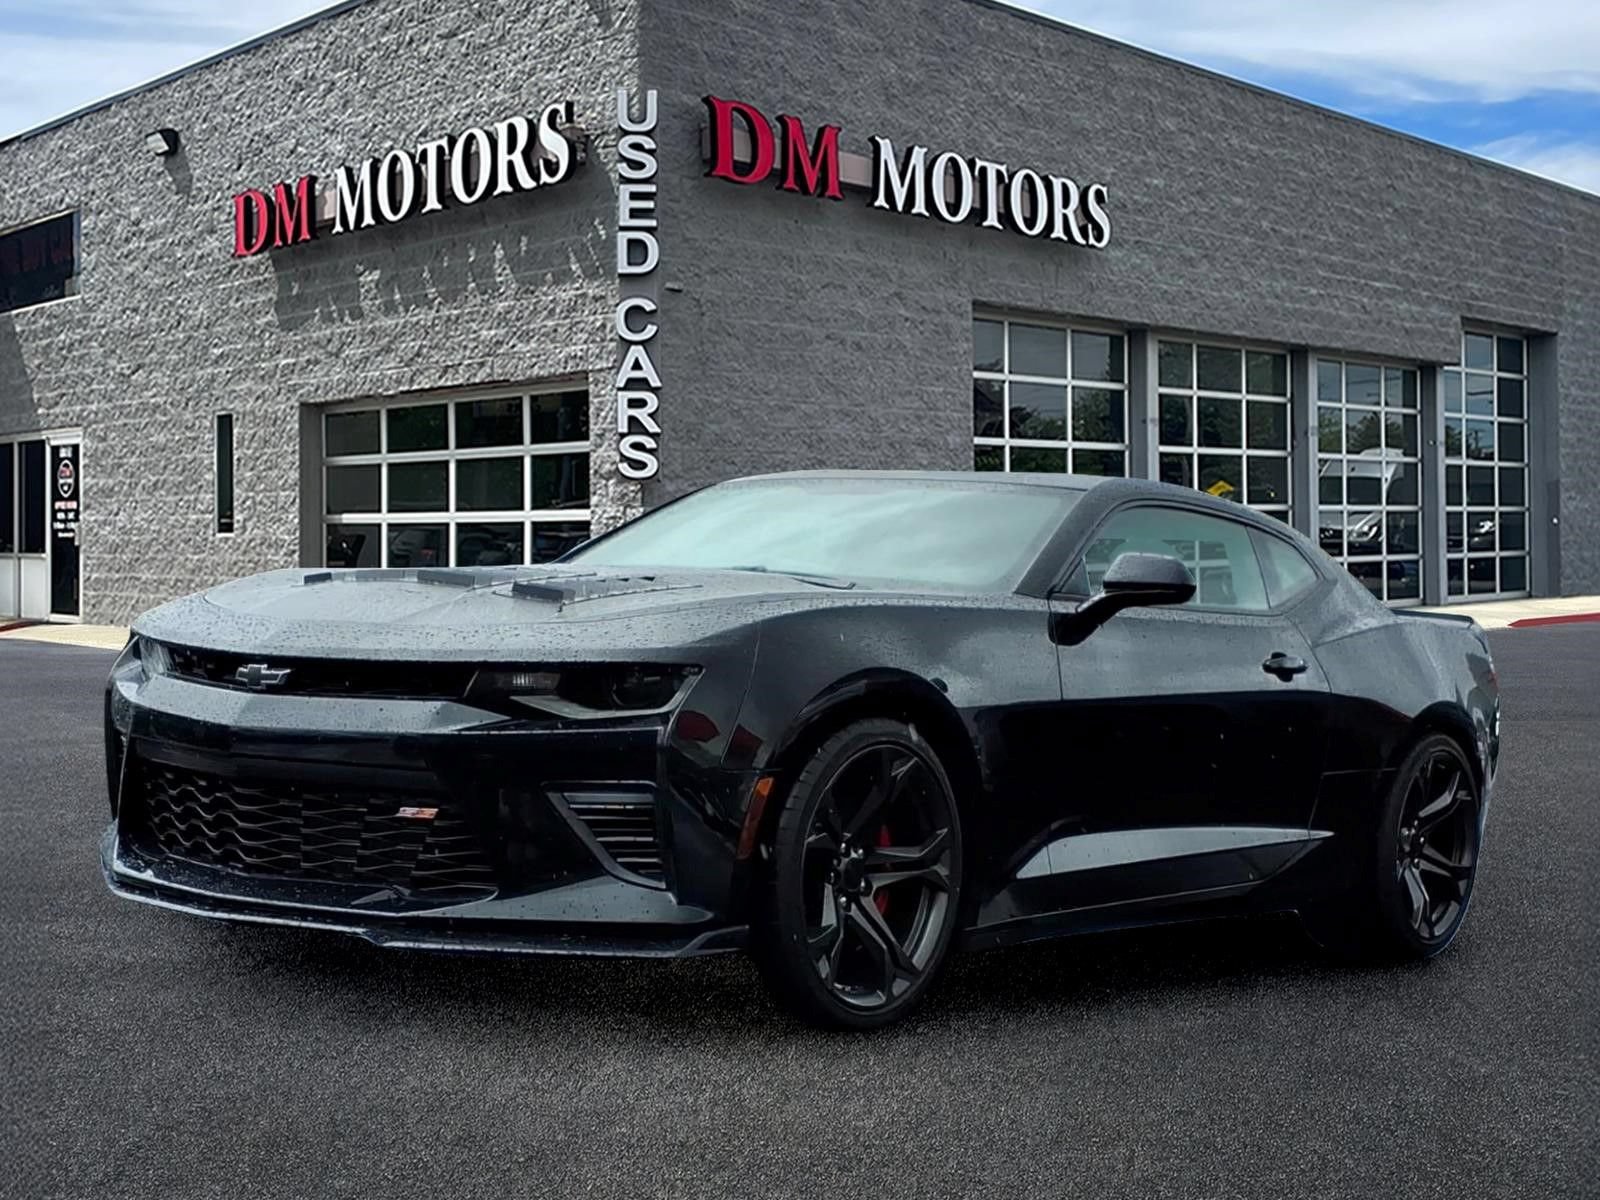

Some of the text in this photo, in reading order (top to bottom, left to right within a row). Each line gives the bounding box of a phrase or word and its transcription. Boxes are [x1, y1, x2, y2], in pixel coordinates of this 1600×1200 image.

[232, 101, 573, 258] DM MOTORS
[704, 96, 1111, 248] DM MOTORS
[616, 89, 662, 479] USED CARS
